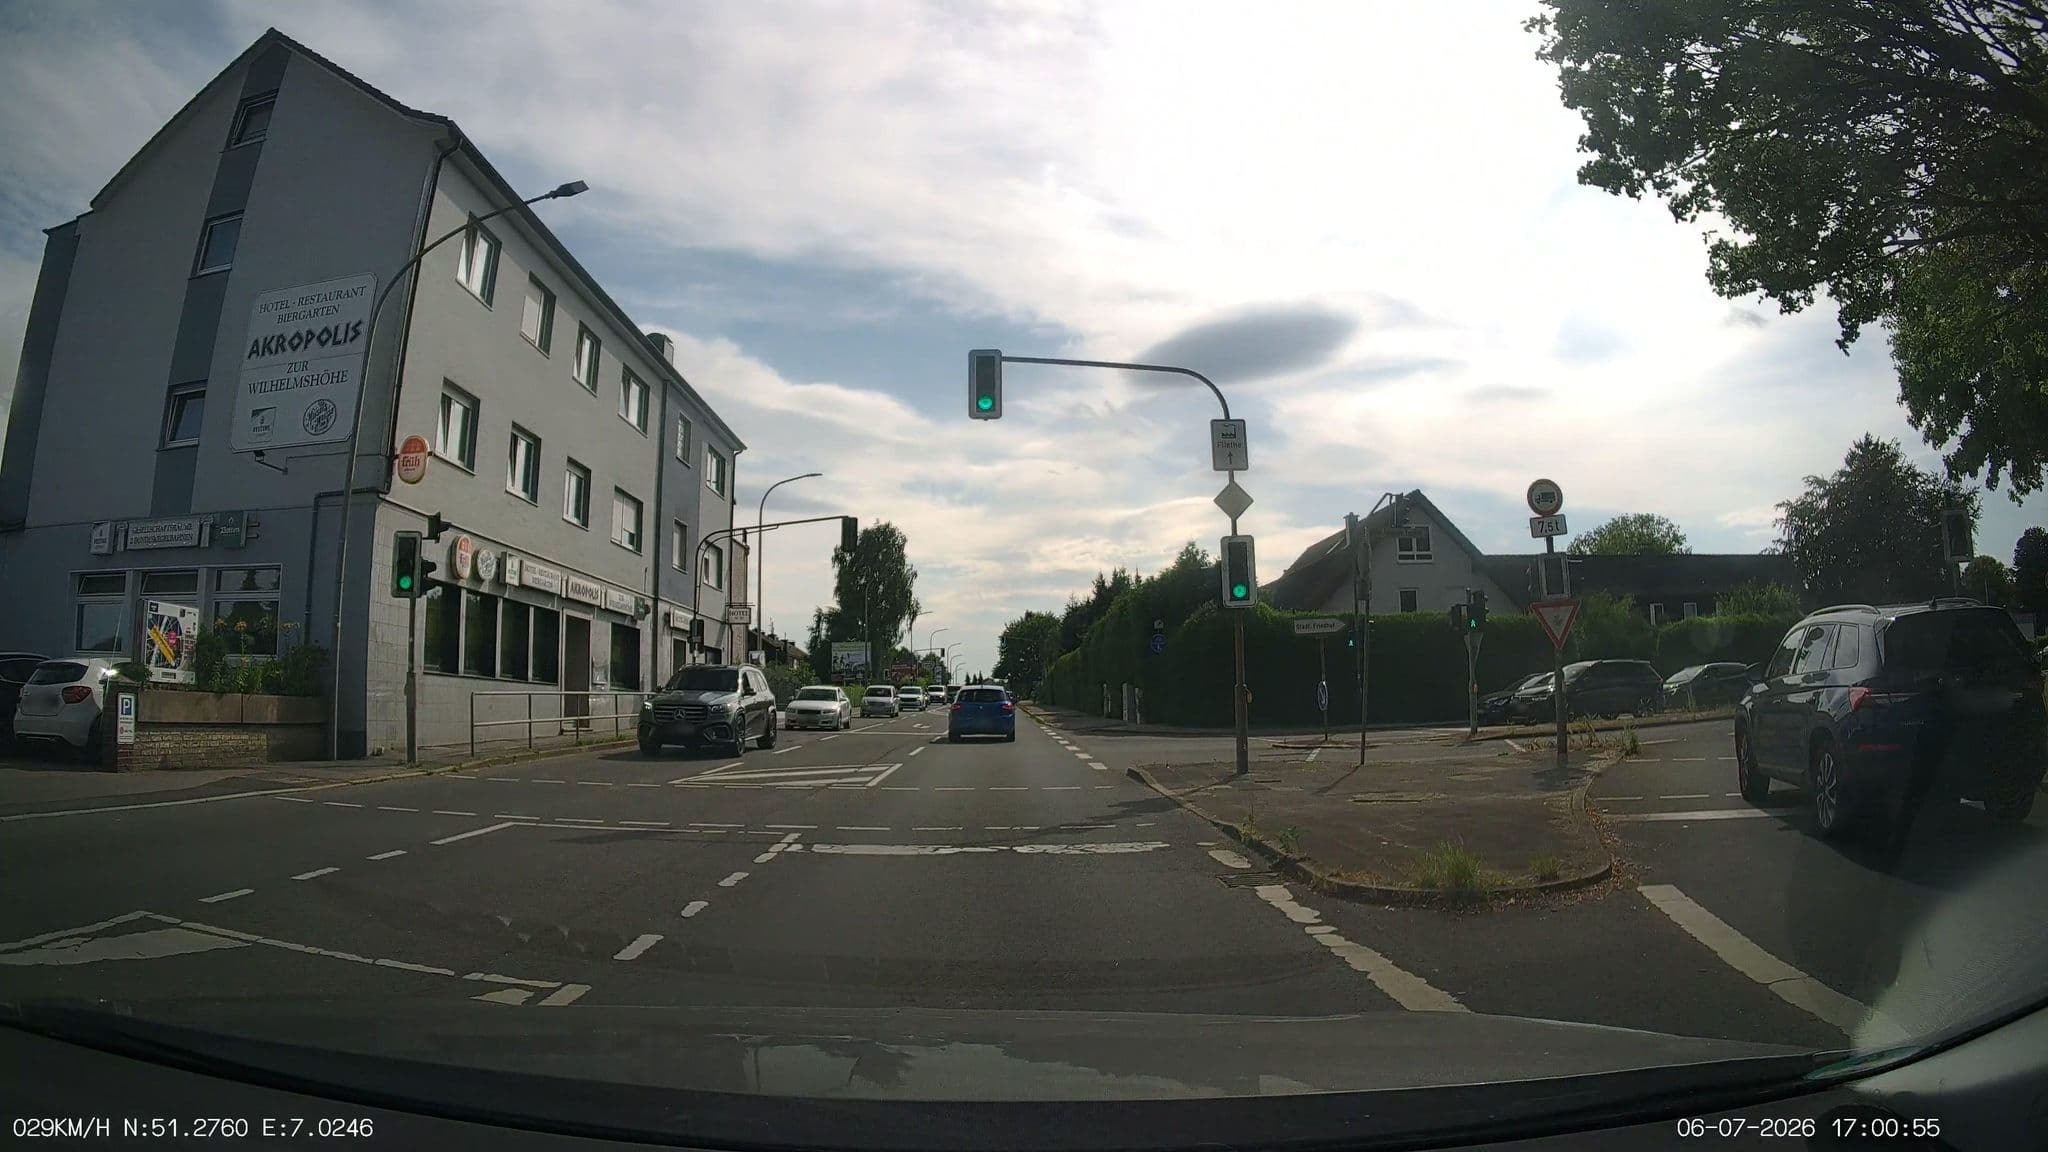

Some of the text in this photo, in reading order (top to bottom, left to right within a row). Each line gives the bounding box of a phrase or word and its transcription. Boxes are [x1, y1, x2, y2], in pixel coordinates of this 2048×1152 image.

[259, 299, 290, 314] HOTEL
[298, 286, 367, 307] RESTAURANT
[277, 304, 340, 324] BIERGARTEN
[248, 320, 363, 359] AKROPOLIS
[287, 361, 309, 374] ZUR
[248, 370, 349, 395] WILHELMSHÖHE
[570, 580, 599, 600] AKROPOLIS
